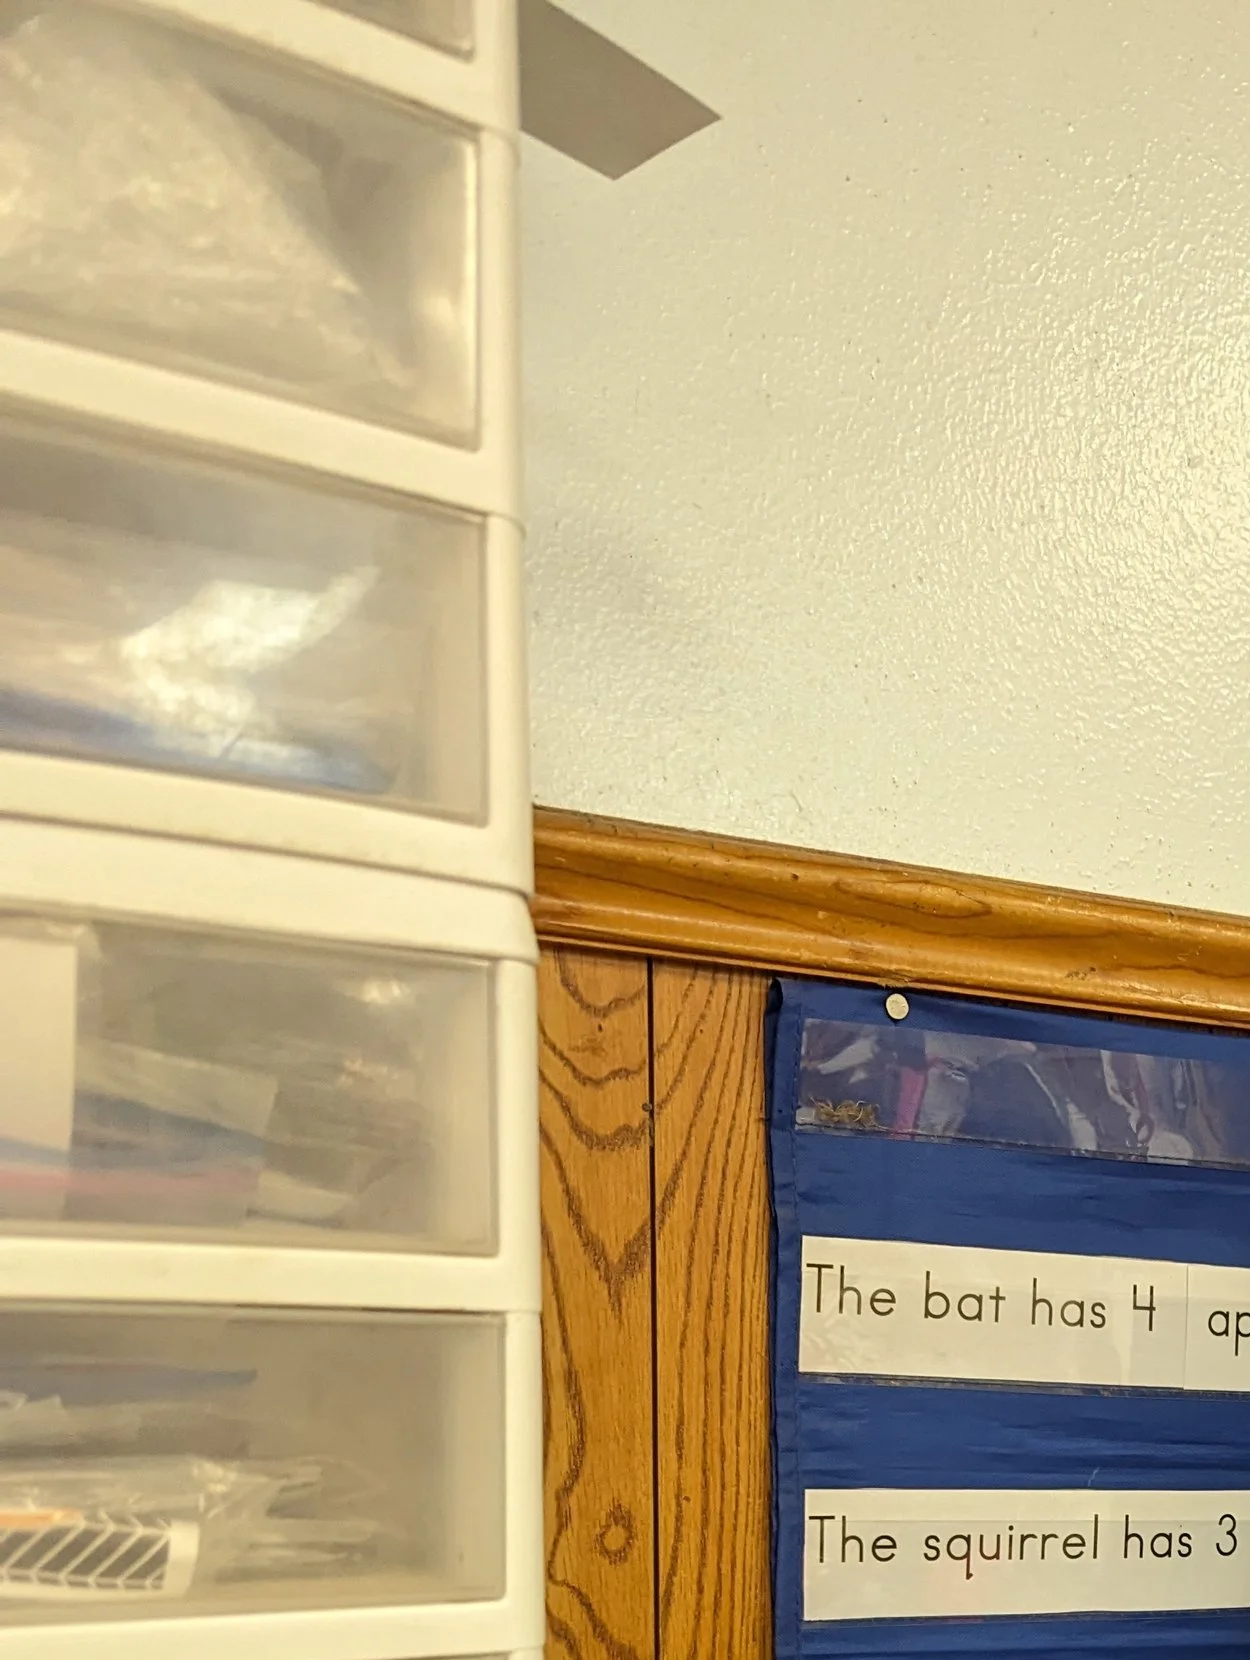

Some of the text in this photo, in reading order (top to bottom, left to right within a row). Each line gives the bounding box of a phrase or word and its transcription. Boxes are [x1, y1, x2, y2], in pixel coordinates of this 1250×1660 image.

[806, 1262, 897, 1317] The
[923, 1270, 1006, 1323] bat
[1031, 1277, 1106, 1329] has
[1132, 1284, 1157, 1332] 4
[808, 1515, 898, 1564] The
[923, 1513, 1099, 1581] squirrel
[1123, 1514, 1193, 1559] has
[1215, 1513, 1238, 1557] 3
